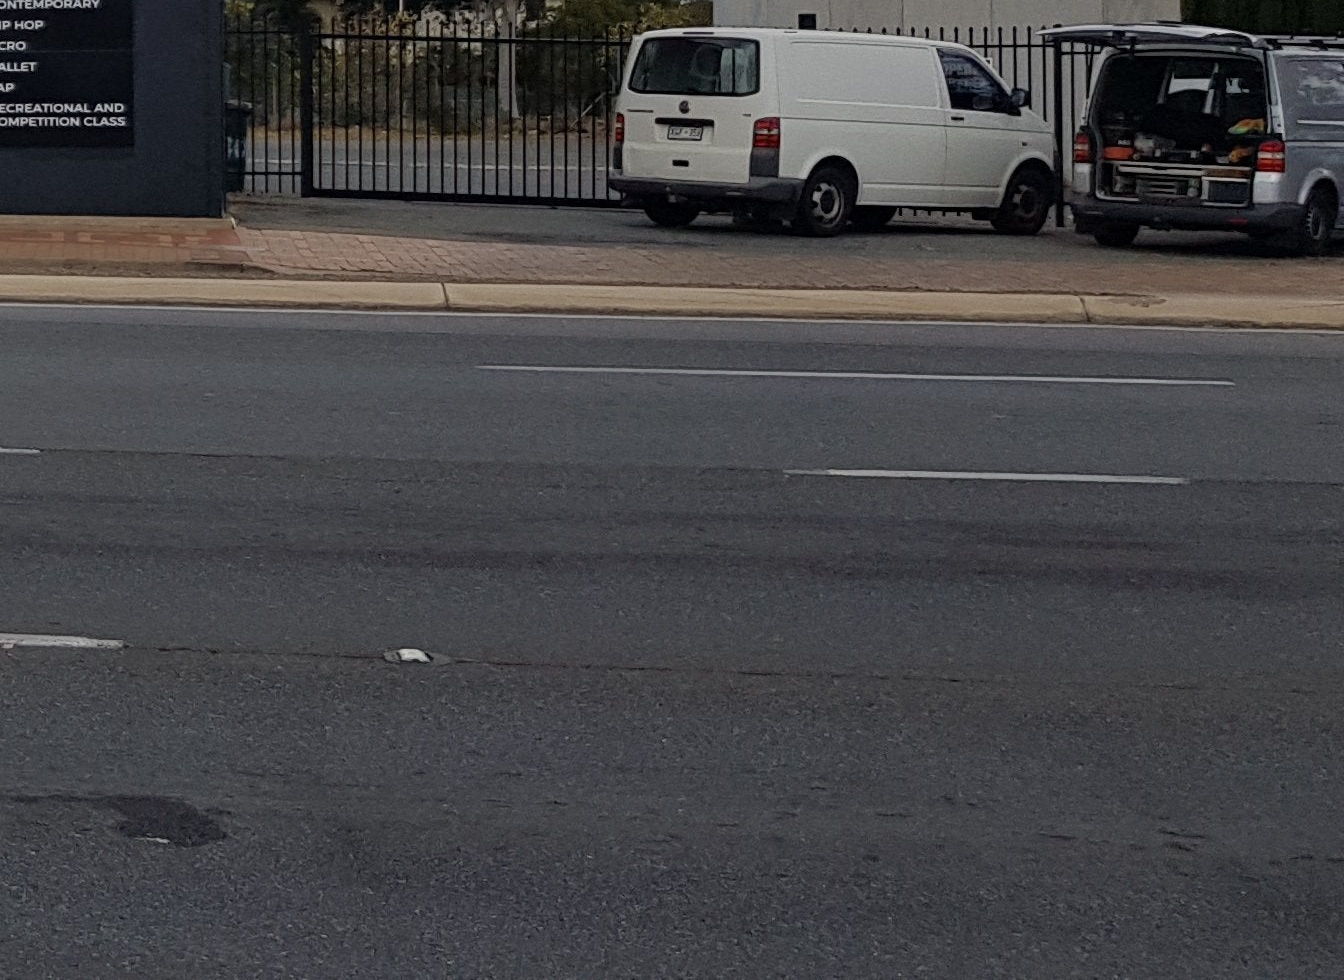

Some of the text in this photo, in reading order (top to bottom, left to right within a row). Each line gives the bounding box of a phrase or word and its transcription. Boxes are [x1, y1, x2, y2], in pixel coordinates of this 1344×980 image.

[14, 19, 45, 31] HOP
[93, 102, 125, 113] AND
[83, 116, 127, 127] CLASS
